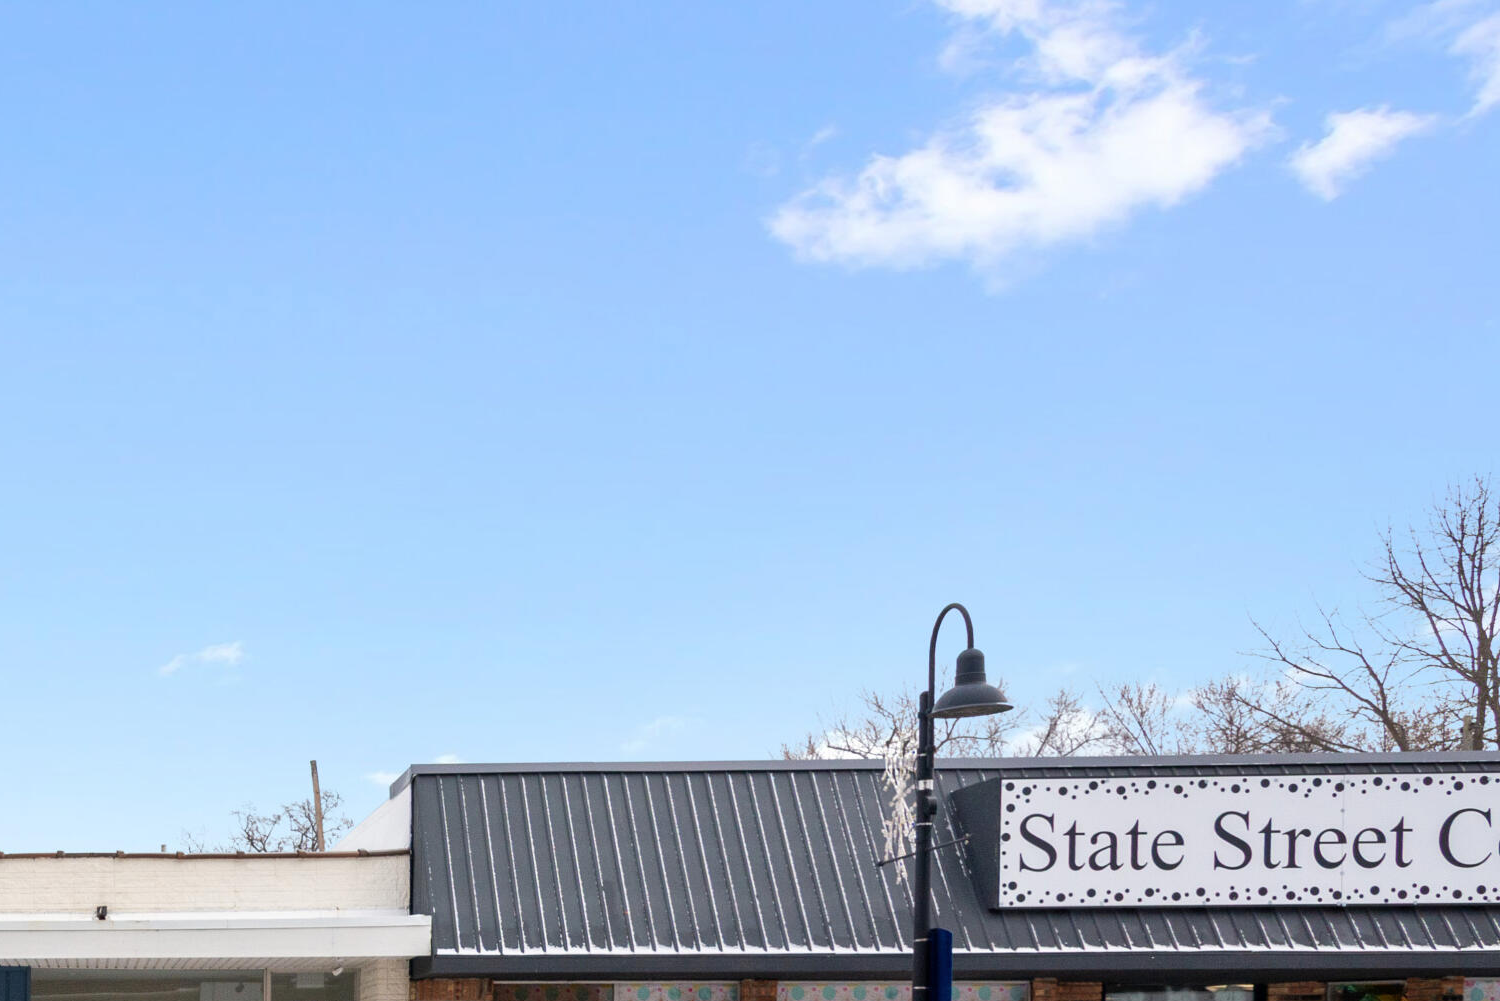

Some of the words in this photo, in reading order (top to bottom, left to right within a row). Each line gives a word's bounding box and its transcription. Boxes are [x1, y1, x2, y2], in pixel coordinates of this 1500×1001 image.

[1019, 813, 1185, 873] State
[1213, 810, 1414, 870] Street
[1438, 807, 1500, 869] C
